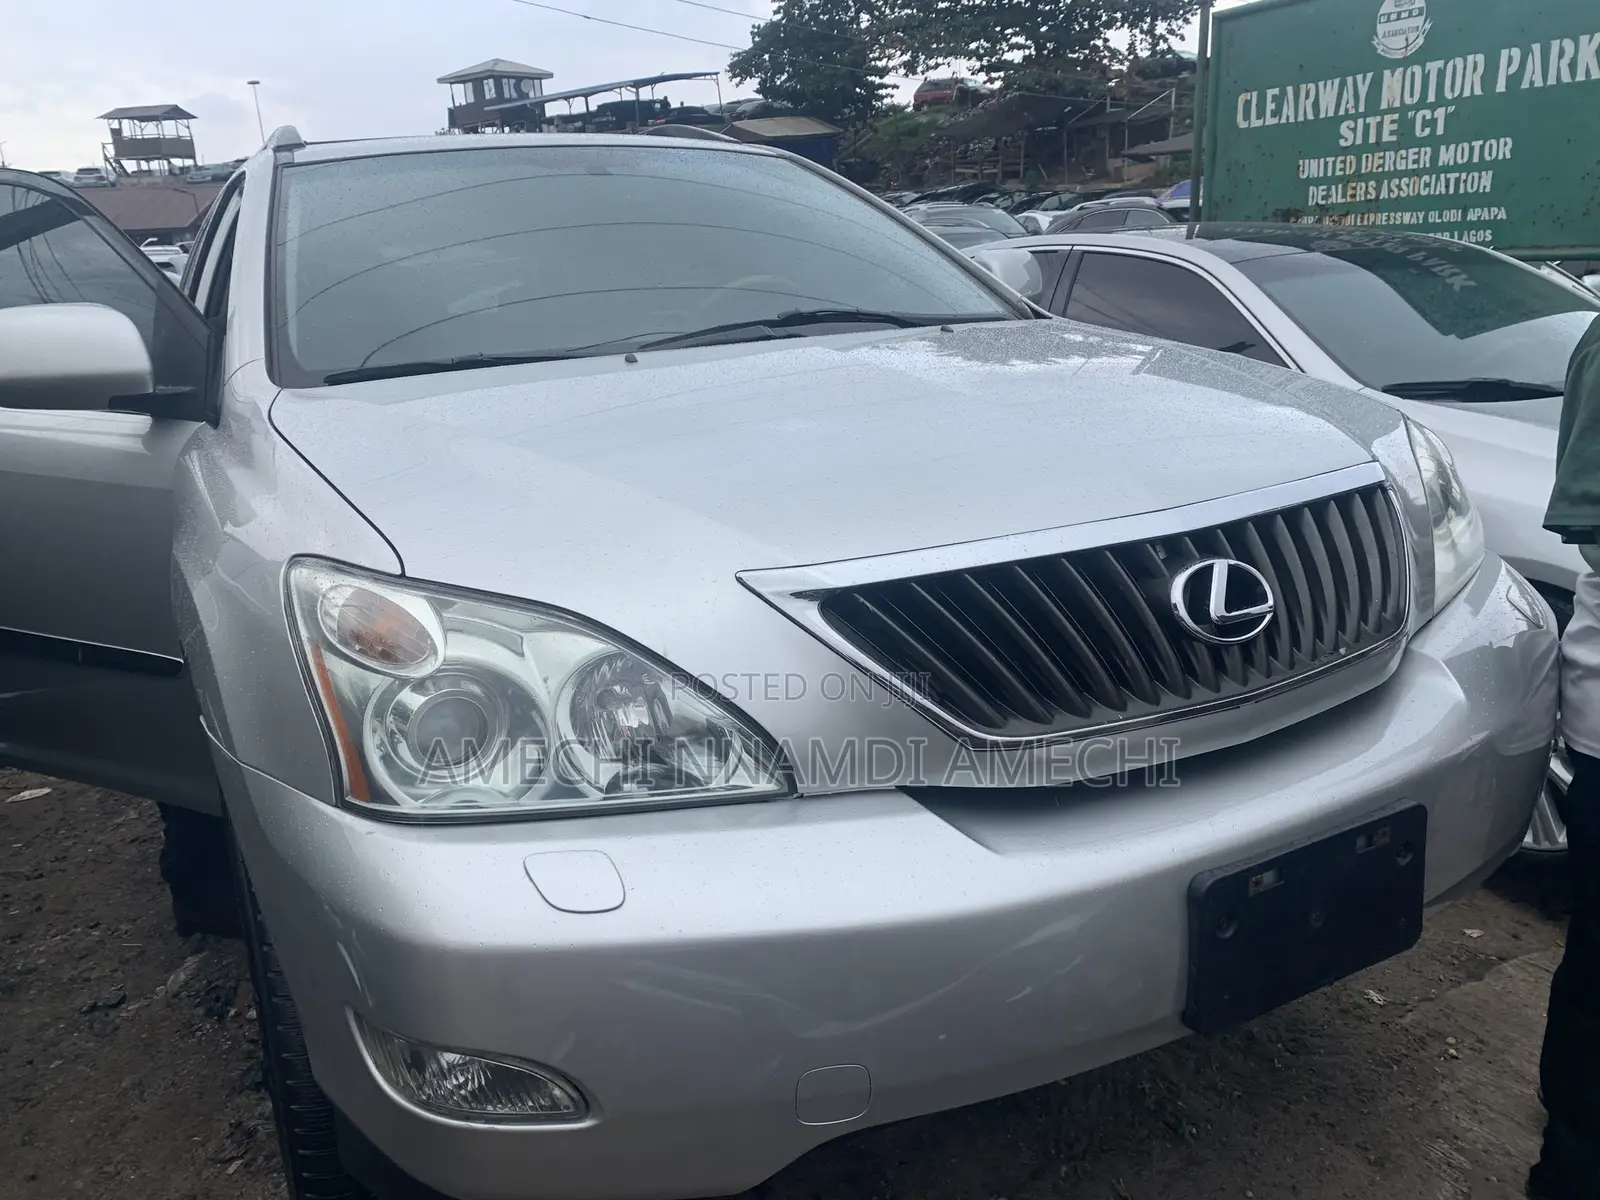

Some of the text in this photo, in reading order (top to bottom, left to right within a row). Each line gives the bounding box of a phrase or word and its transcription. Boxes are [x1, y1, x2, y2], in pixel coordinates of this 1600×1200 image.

[1236, 31, 1600, 129] CLEARWAY MOTOR PARK
[1338, 113, 1400, 148] SITE
[1299, 154, 1357, 180] UNITED
[1438, 137, 1513, 167] MOTOR
[1308, 170, 1493, 206] DEALERS ASSOCIATION
[1356, 210, 1425, 226] EXPRESSWAY
[1428, 208, 1462, 223] OLODI
[1466, 206, 1508, 221] APAPA
[1453, 229, 1493, 243] LAGOS
